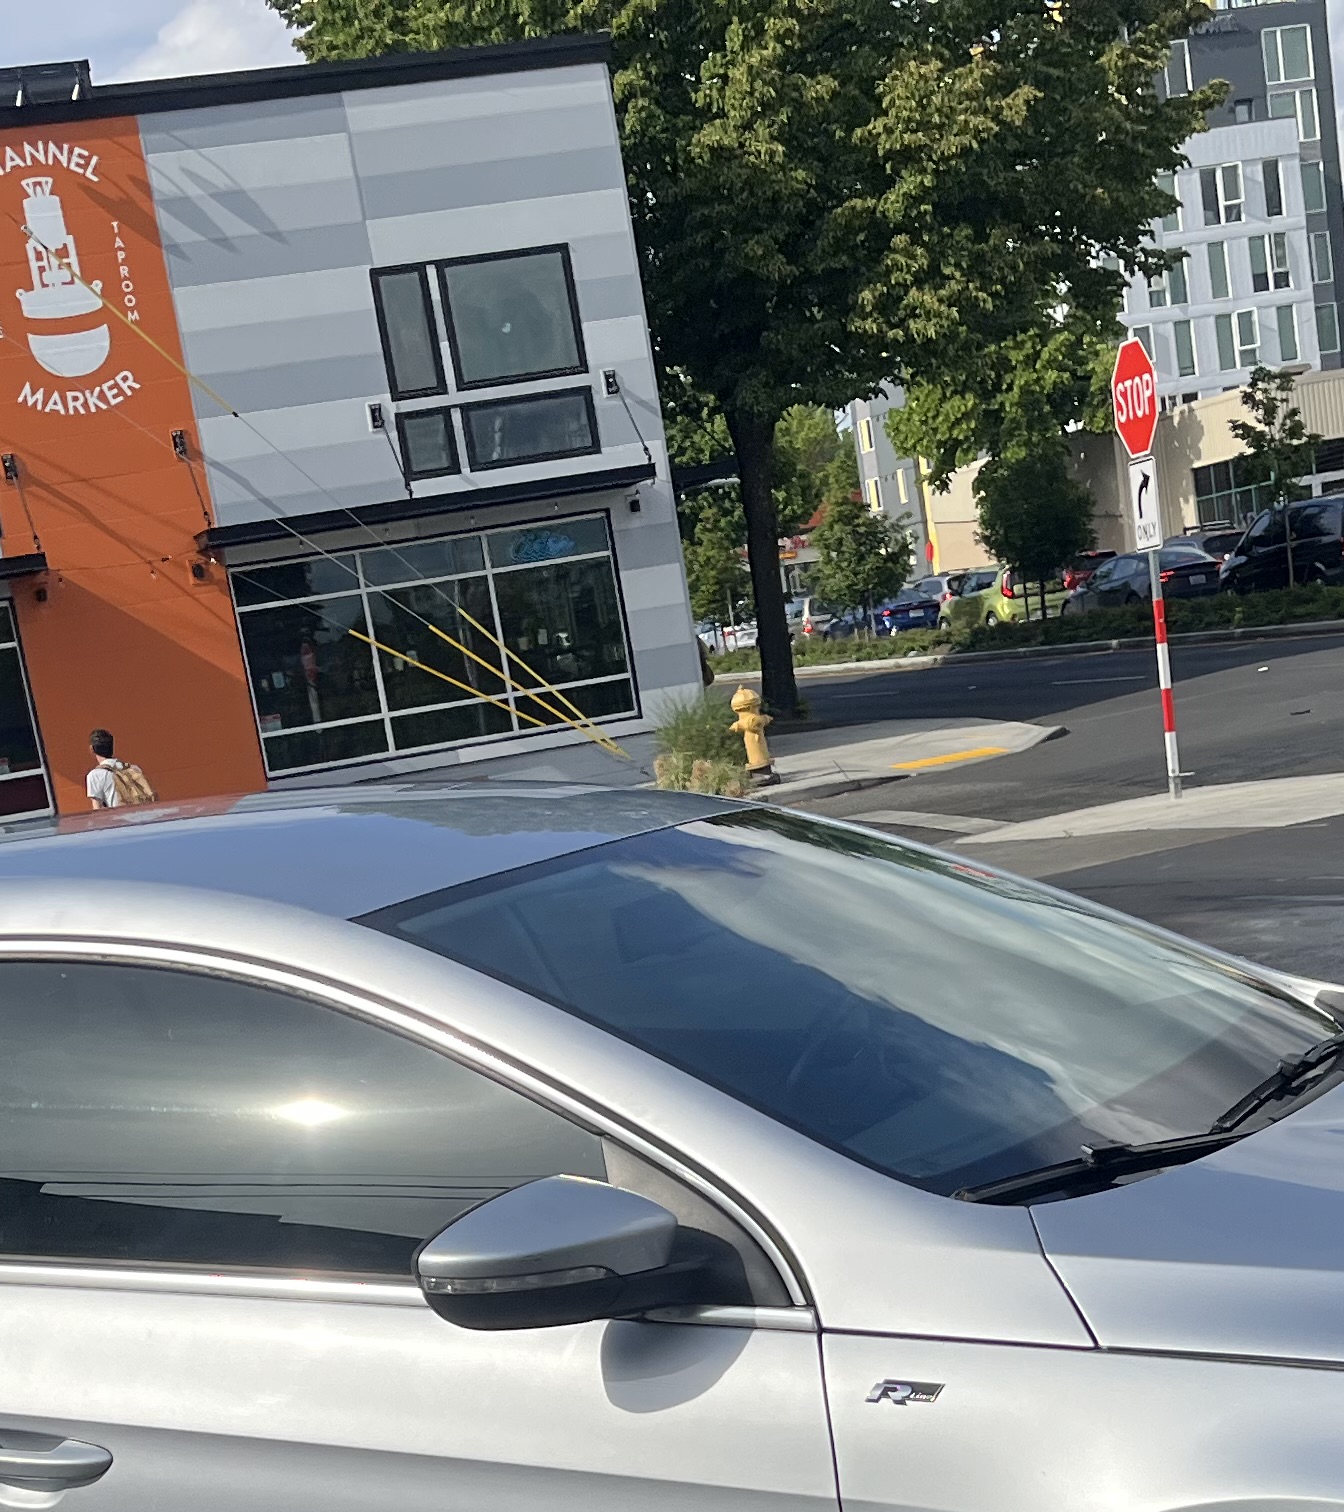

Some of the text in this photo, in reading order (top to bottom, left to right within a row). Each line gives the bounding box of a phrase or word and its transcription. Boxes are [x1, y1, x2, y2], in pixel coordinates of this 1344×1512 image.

[111, 221, 140, 322] TAPROOM
[17, 370, 141, 416] MARKER
[1115, 372, 1154, 424] STOP
[1137, 522, 1157, 541] ONLY
